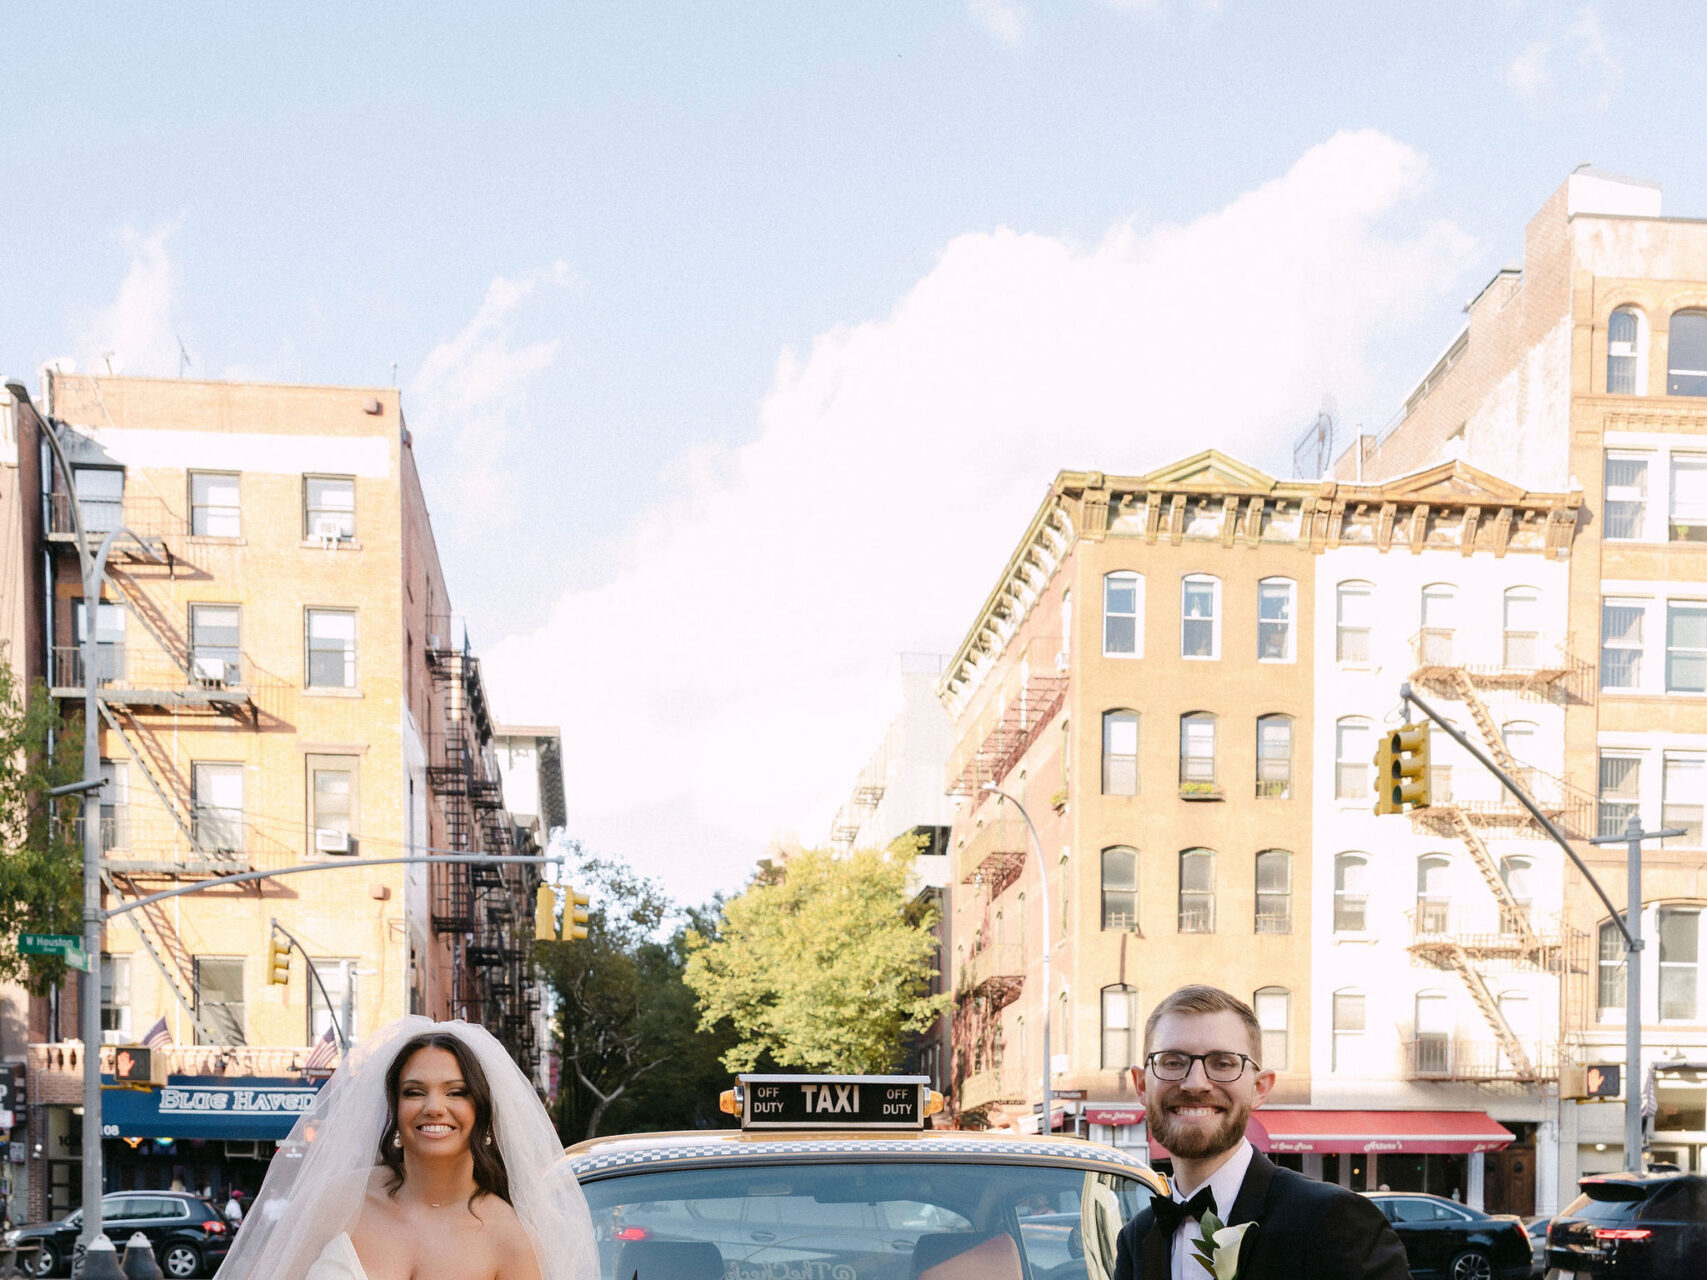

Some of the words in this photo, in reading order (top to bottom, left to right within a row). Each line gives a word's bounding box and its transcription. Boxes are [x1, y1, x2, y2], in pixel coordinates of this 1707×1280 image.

[26, 936, 33, 946] W
[37, 936, 73, 947] Houston
[757, 1087, 779, 1098] OFF
[886, 1089, 908, 1100] OFF
[801, 1085, 859, 1113] TAXI
[754, 1102, 783, 1113] DUTY
[883, 1104, 912, 1115] DUTY
